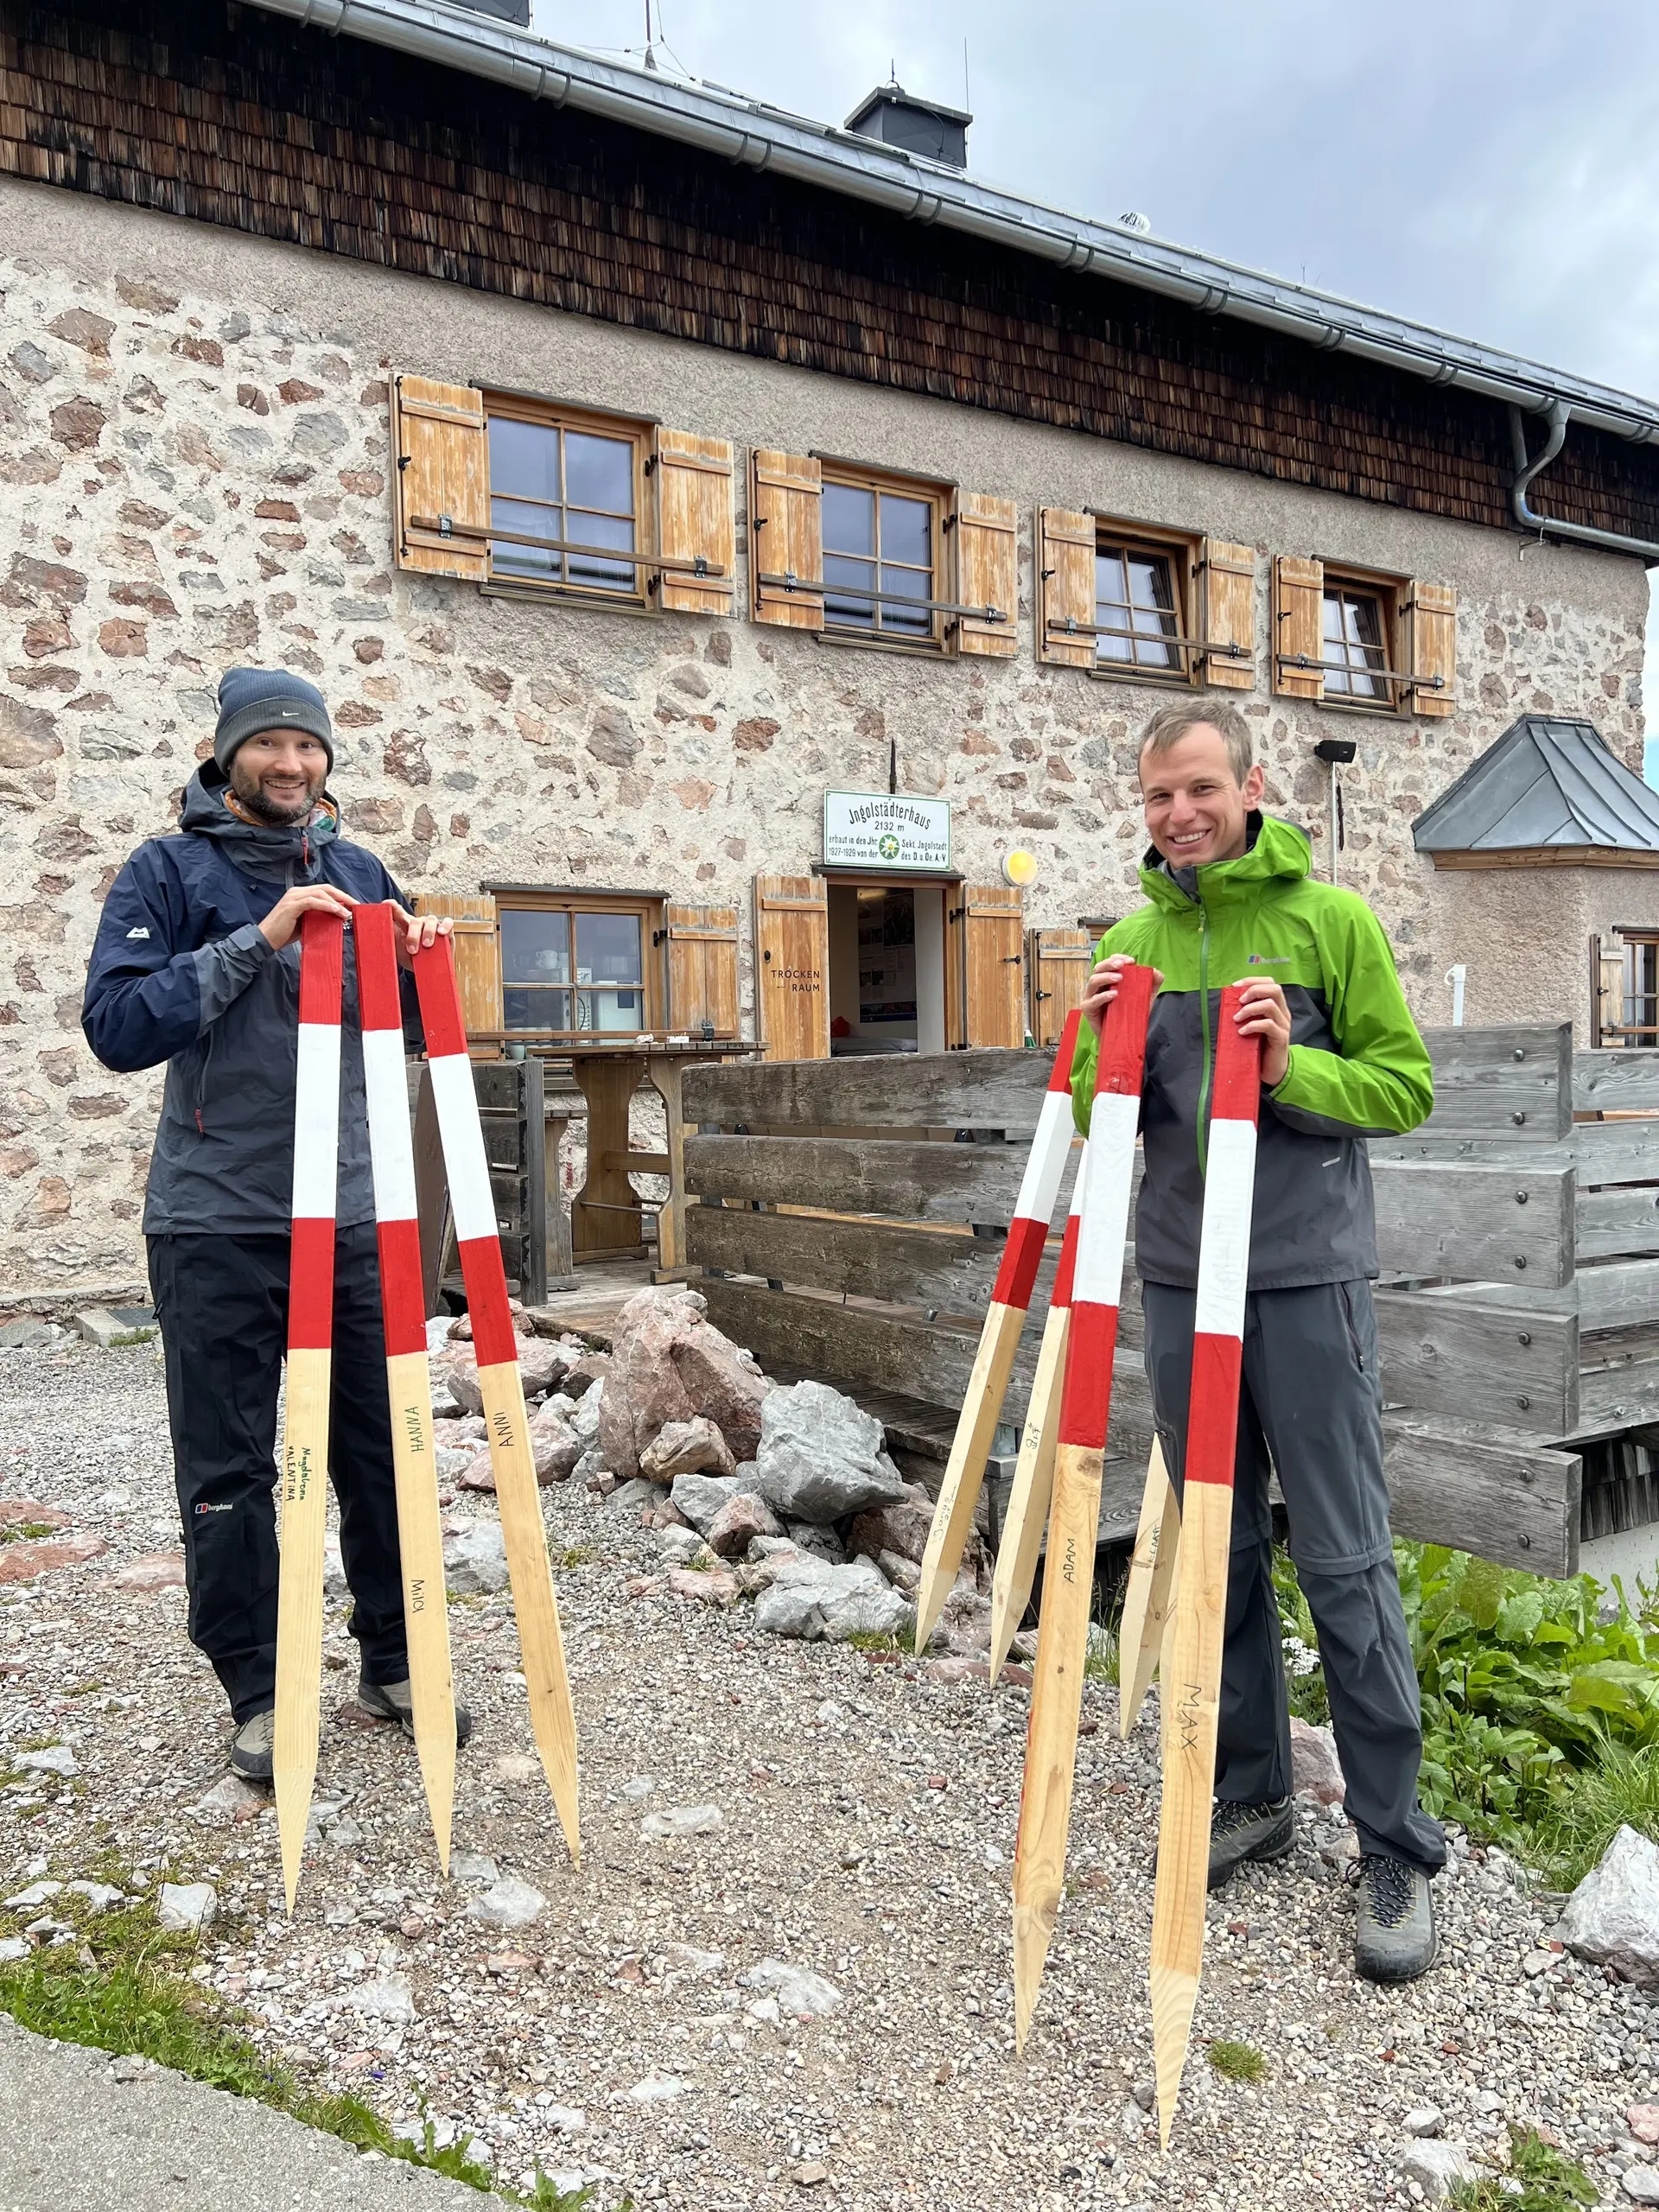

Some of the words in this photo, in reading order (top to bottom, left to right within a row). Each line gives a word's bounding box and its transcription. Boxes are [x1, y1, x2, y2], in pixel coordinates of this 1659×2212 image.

[874, 821, 893, 831] 2132
[829, 834, 848, 844] erbaut
[855, 836, 867, 845] den
[829, 847, 856, 857] 1927-1929
[868, 849, 879, 858] der
[900, 851, 912, 861] des
[771, 969, 821, 979] TROCKEN
[791, 984, 821, 993] RAUM
[404, 1406, 424, 1452] HANNA
[493, 1411, 514, 1447] ANNI
[1063, 1538, 1075, 1584] ADAM
[1180, 1683, 1202, 1751] MAX
